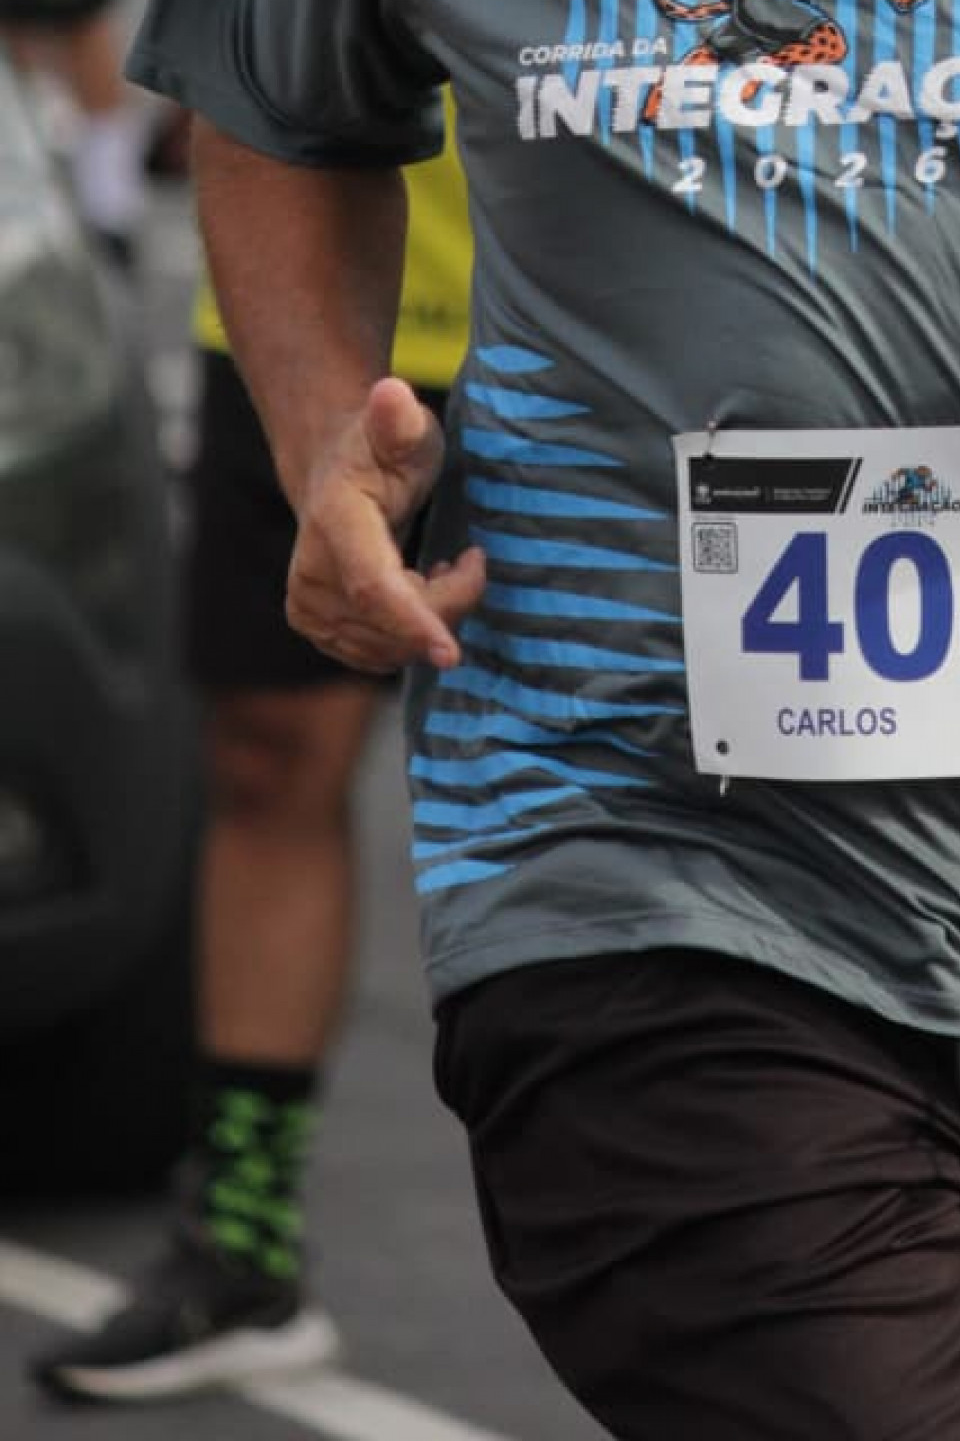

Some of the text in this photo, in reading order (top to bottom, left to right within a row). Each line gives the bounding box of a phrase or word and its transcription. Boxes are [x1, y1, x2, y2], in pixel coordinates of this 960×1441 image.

[519, 38, 668, 66] CORRIDA DA
[777, 707, 897, 737] CARLOS
